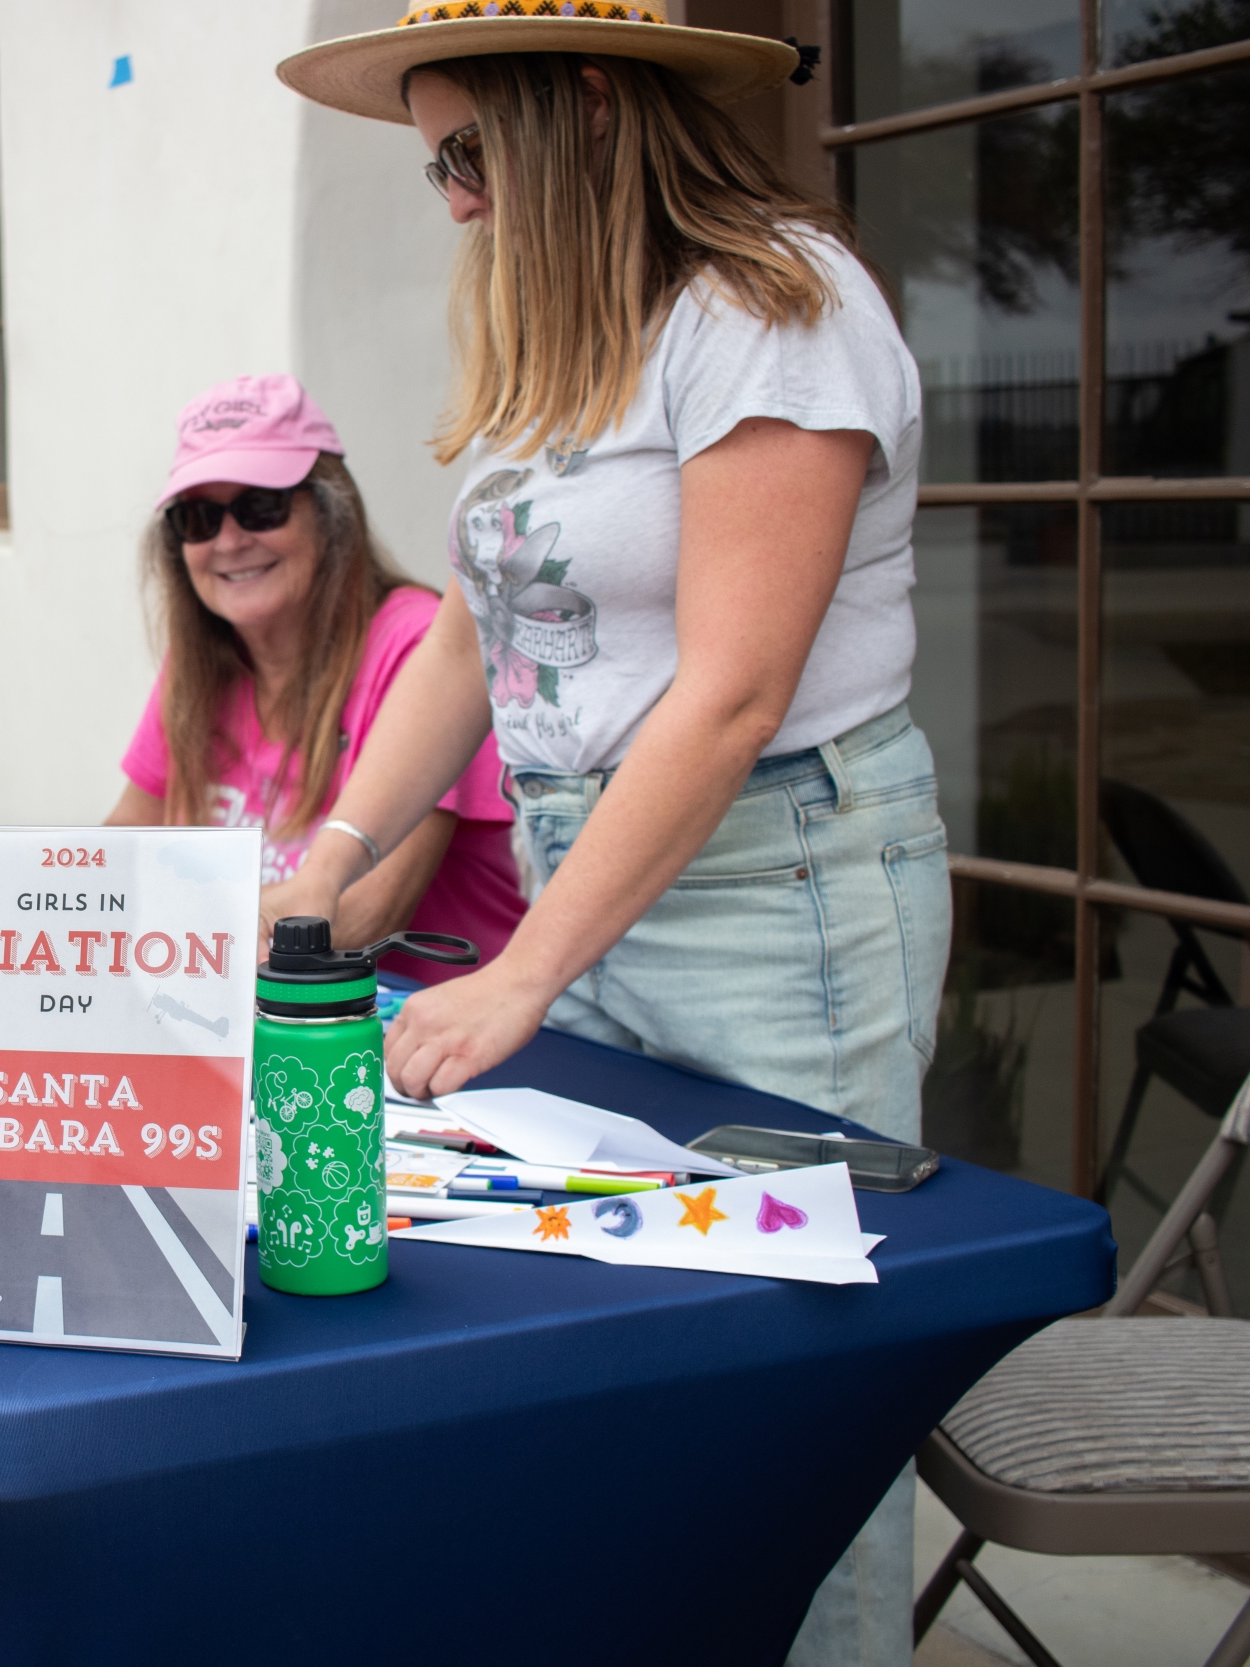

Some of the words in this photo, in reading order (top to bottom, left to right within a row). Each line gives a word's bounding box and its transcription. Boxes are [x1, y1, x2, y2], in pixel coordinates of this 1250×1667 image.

[41, 847, 106, 868] 2024
[17, 893, 88, 912] GIRLS
[100, 894, 125, 912] IN
[40, 994, 93, 1014] DAY
[140, 1122, 223, 1161] 99S
